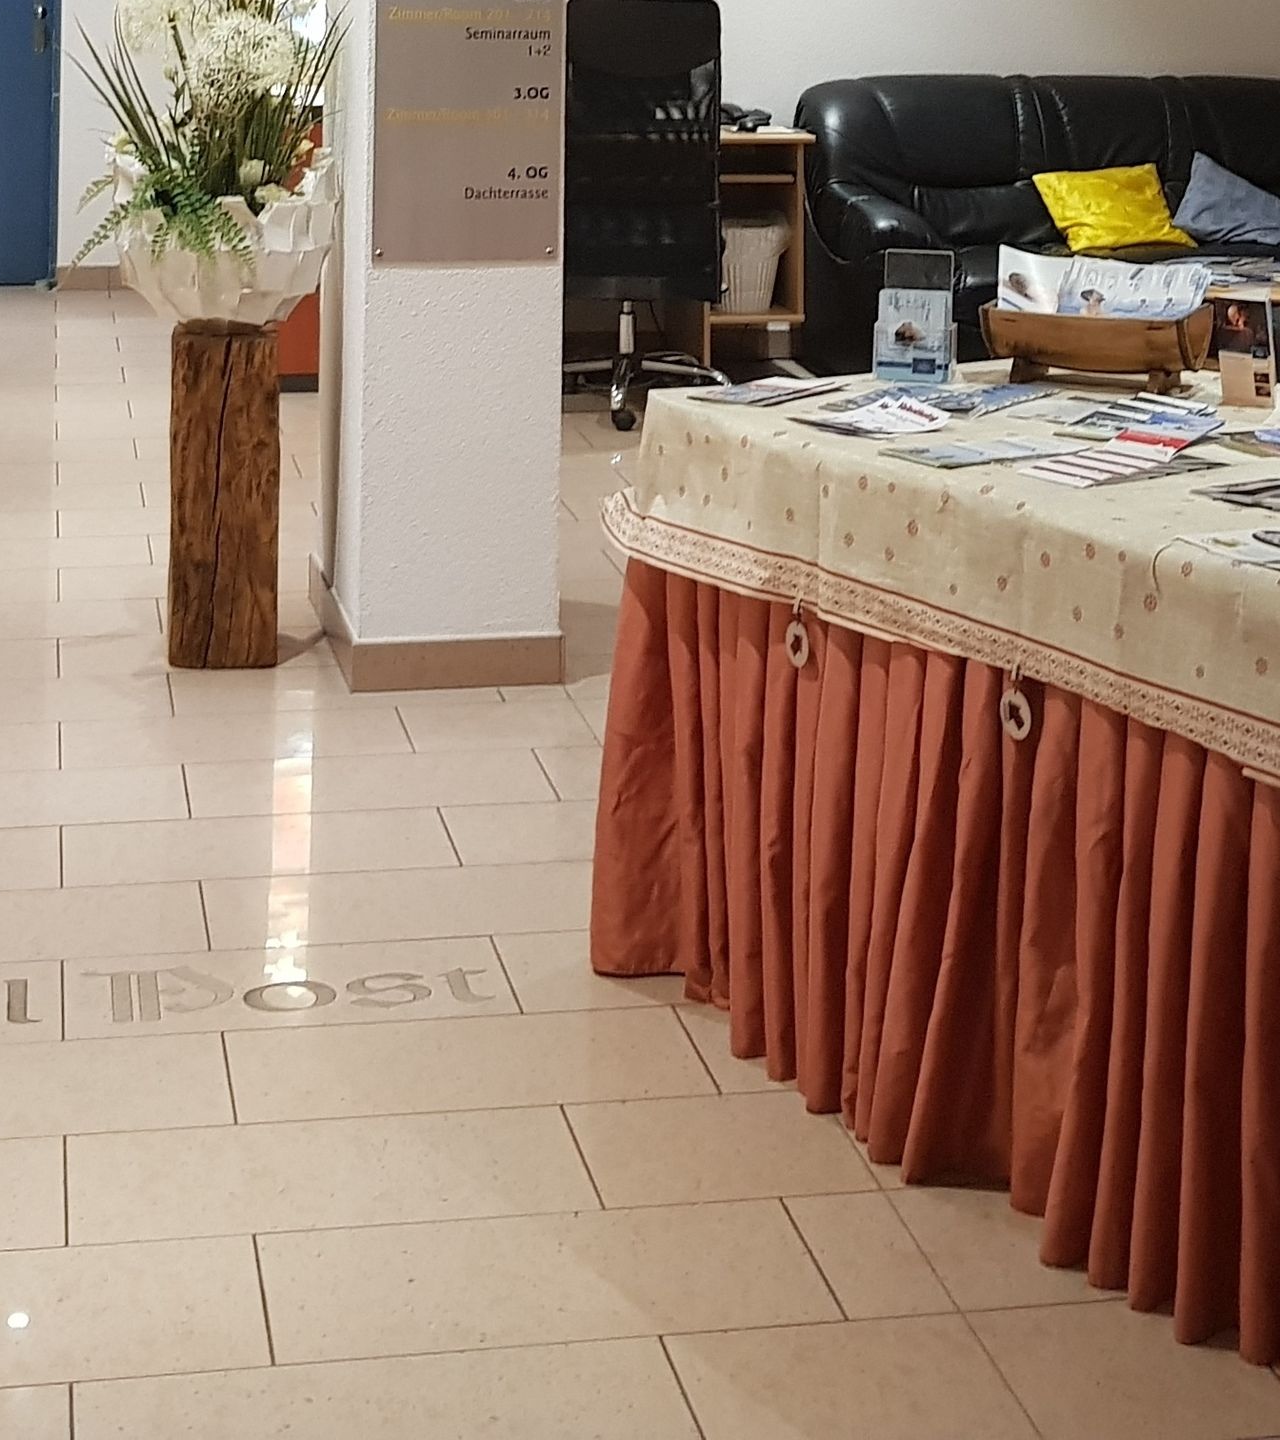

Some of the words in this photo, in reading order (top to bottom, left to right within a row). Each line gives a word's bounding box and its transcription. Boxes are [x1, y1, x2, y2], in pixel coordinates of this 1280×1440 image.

[465, 27, 551, 41] Seminarraum
[513, 87, 550, 100] 3.OG
[525, 166, 549, 179] OG
[464, 187, 549, 200] Dachterrasse
[79, 963, 492, 1023] Post
